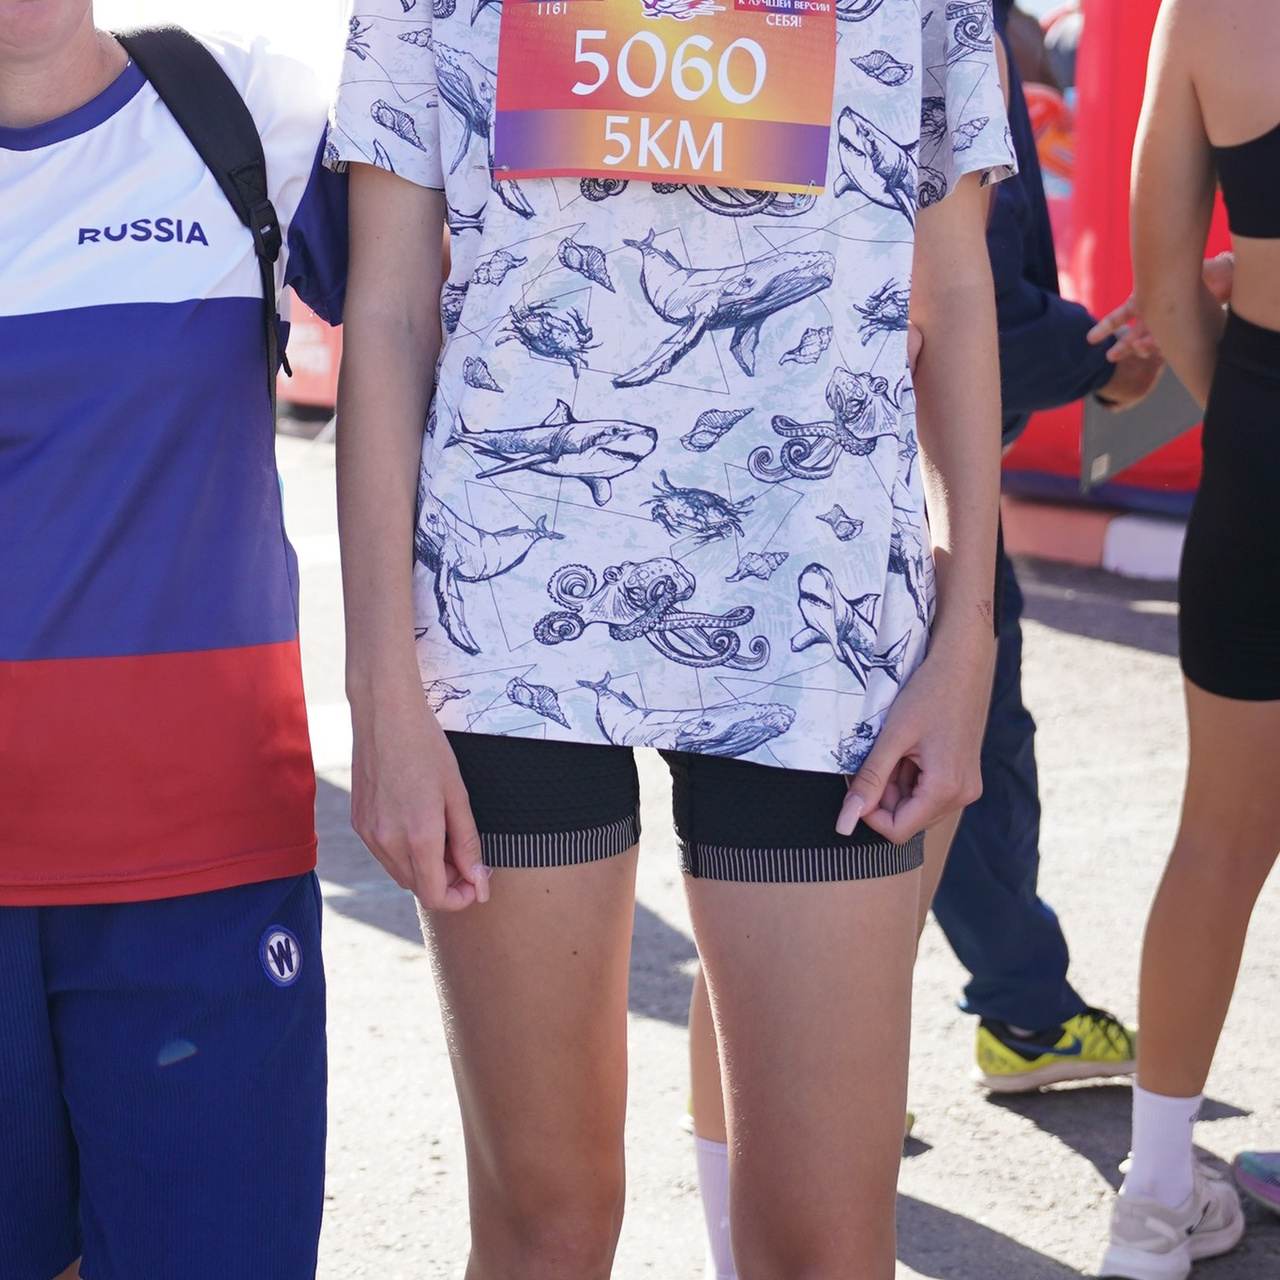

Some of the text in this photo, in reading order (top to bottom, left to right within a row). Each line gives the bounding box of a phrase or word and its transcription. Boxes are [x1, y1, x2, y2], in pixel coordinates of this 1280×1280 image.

[538, 2, 567, 16] 1161
[794, 0, 830, 12] ВЕРСИИ
[766, 13, 802, 28] СЕБЯ!
[571, 29, 767, 105] 5060
[77, 216, 209, 247] RUSSIA
